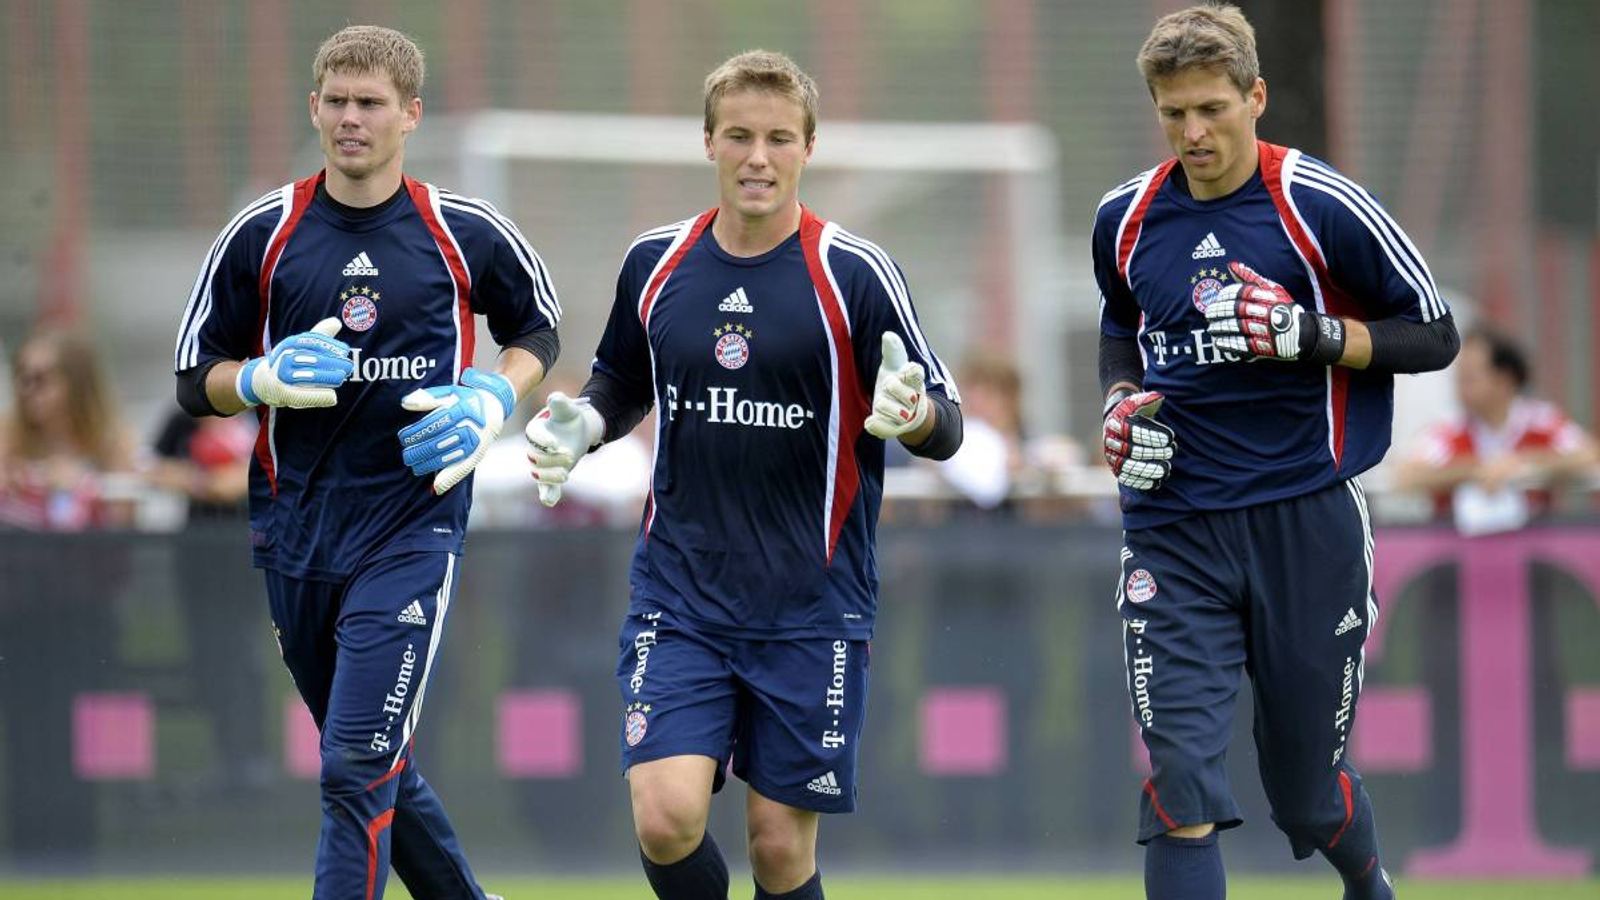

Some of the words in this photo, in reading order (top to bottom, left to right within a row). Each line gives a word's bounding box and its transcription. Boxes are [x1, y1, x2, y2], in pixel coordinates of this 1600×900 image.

[1192, 248, 1226, 259] adidas
[342, 268, 379, 276] adidas
[718, 303, 754, 313] adidas
[404, 413, 452, 445] RESPONSE
[397, 614, 427, 626] adidas
[1335, 618, 1362, 636] adidas
[807, 782, 842, 796] adidas
